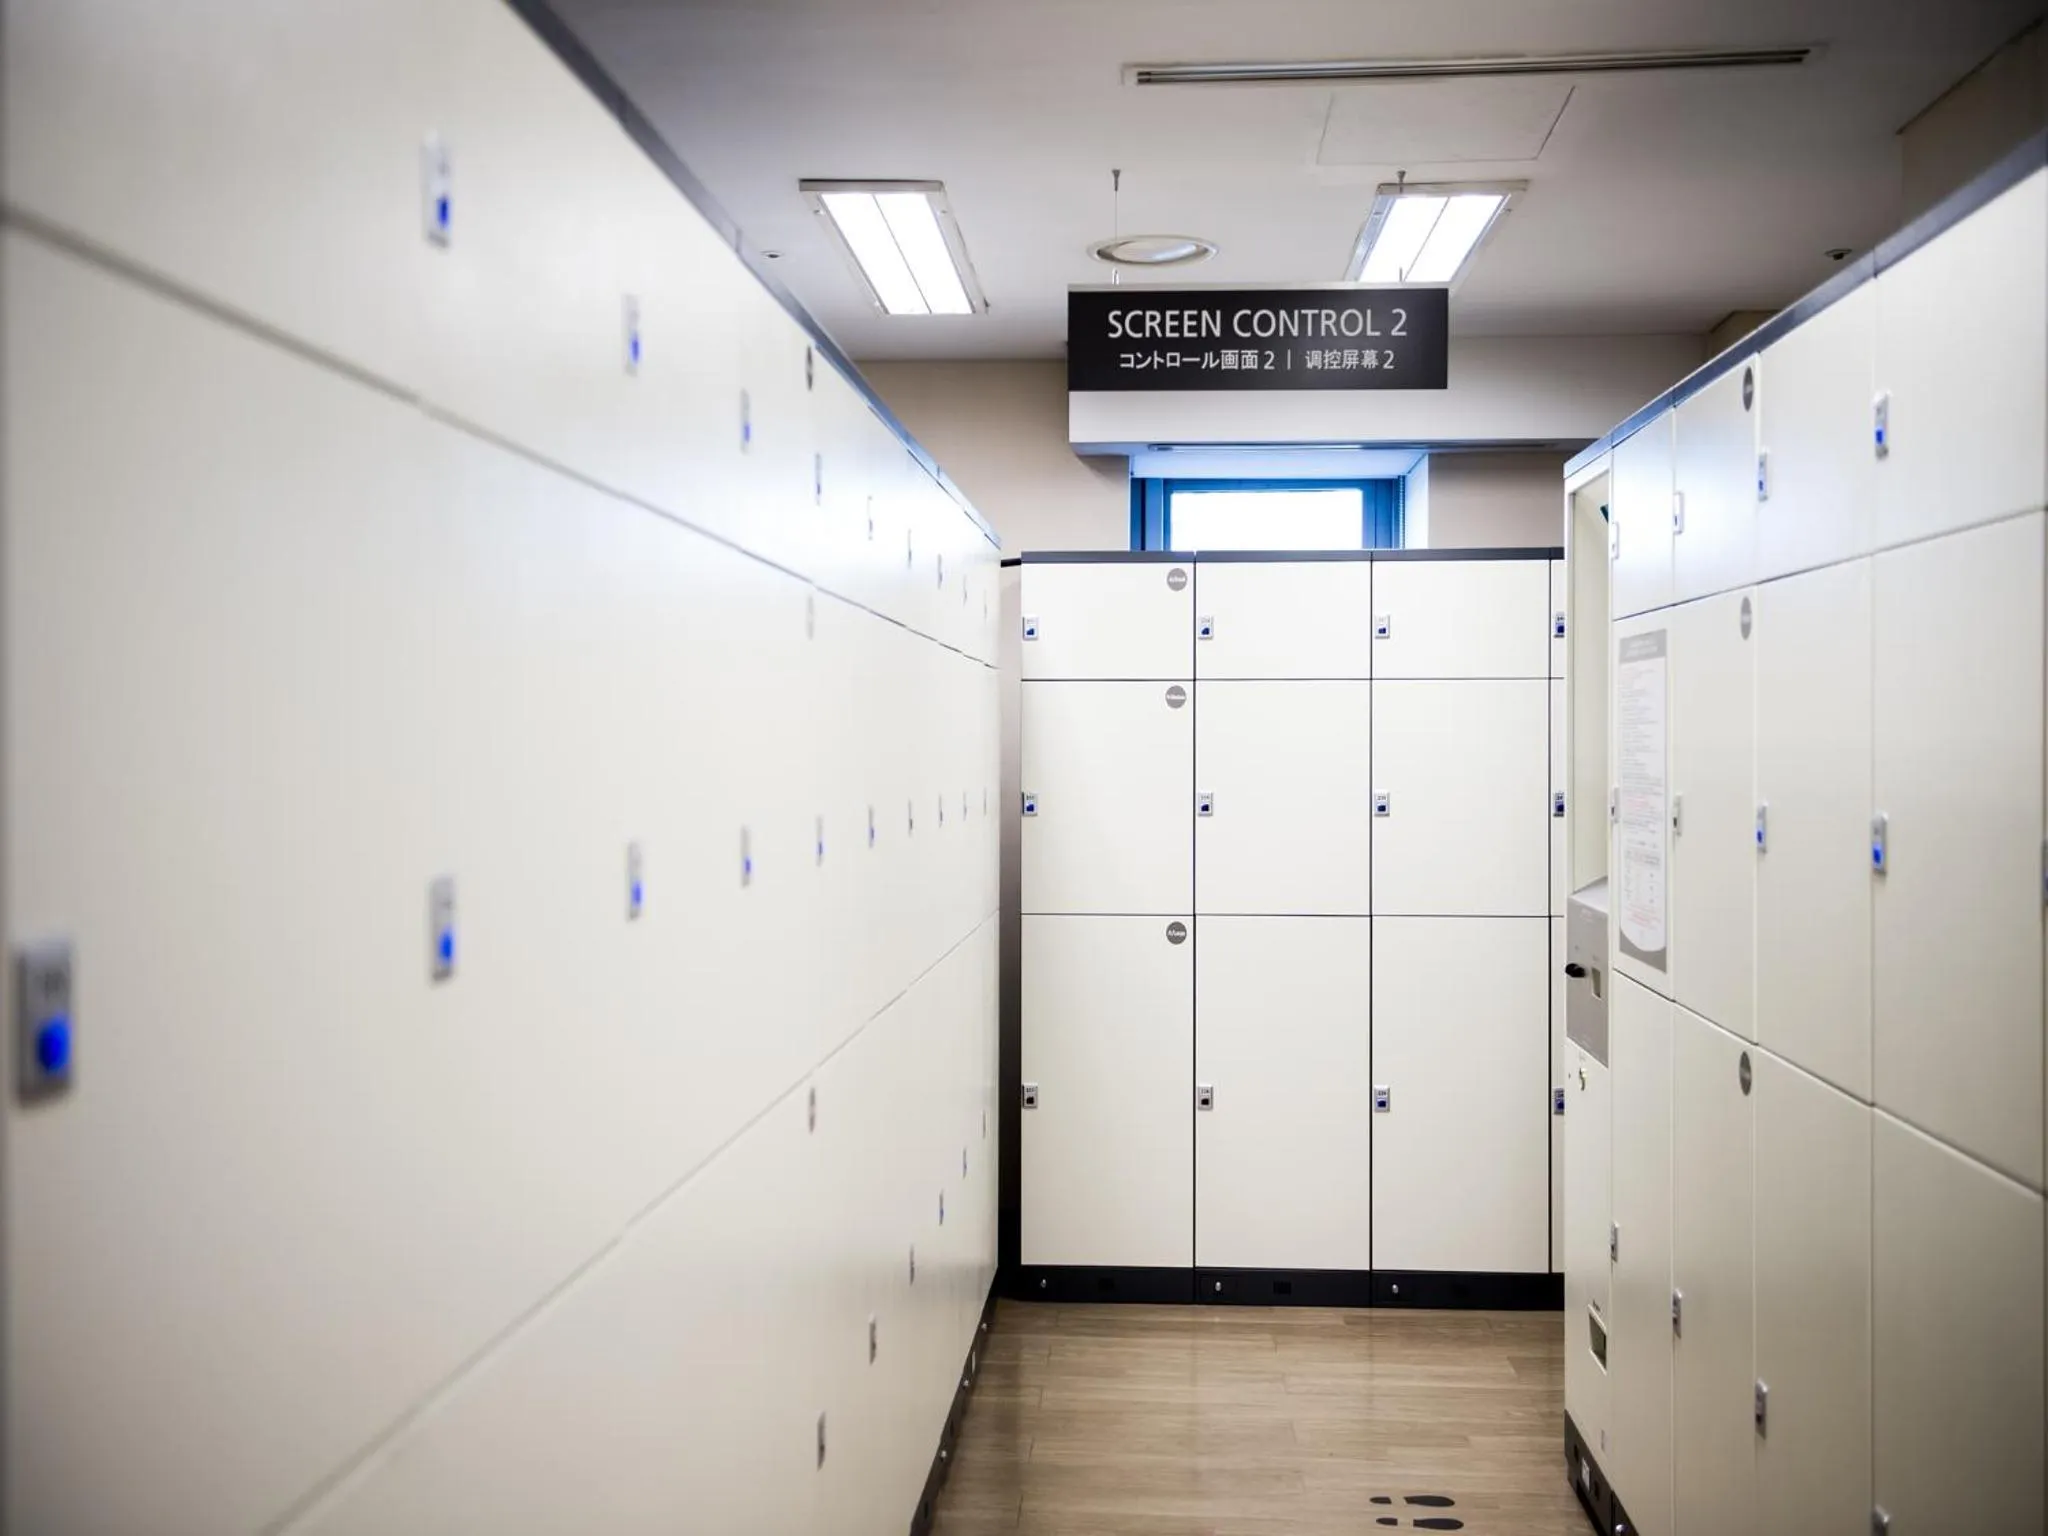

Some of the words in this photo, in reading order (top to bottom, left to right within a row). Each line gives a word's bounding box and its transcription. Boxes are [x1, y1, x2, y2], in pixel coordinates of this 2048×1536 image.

[1107, 309, 1222, 338] SCREEN
[1232, 308, 1382, 338] CONTROL
[1390, 307, 1408, 337] 2
